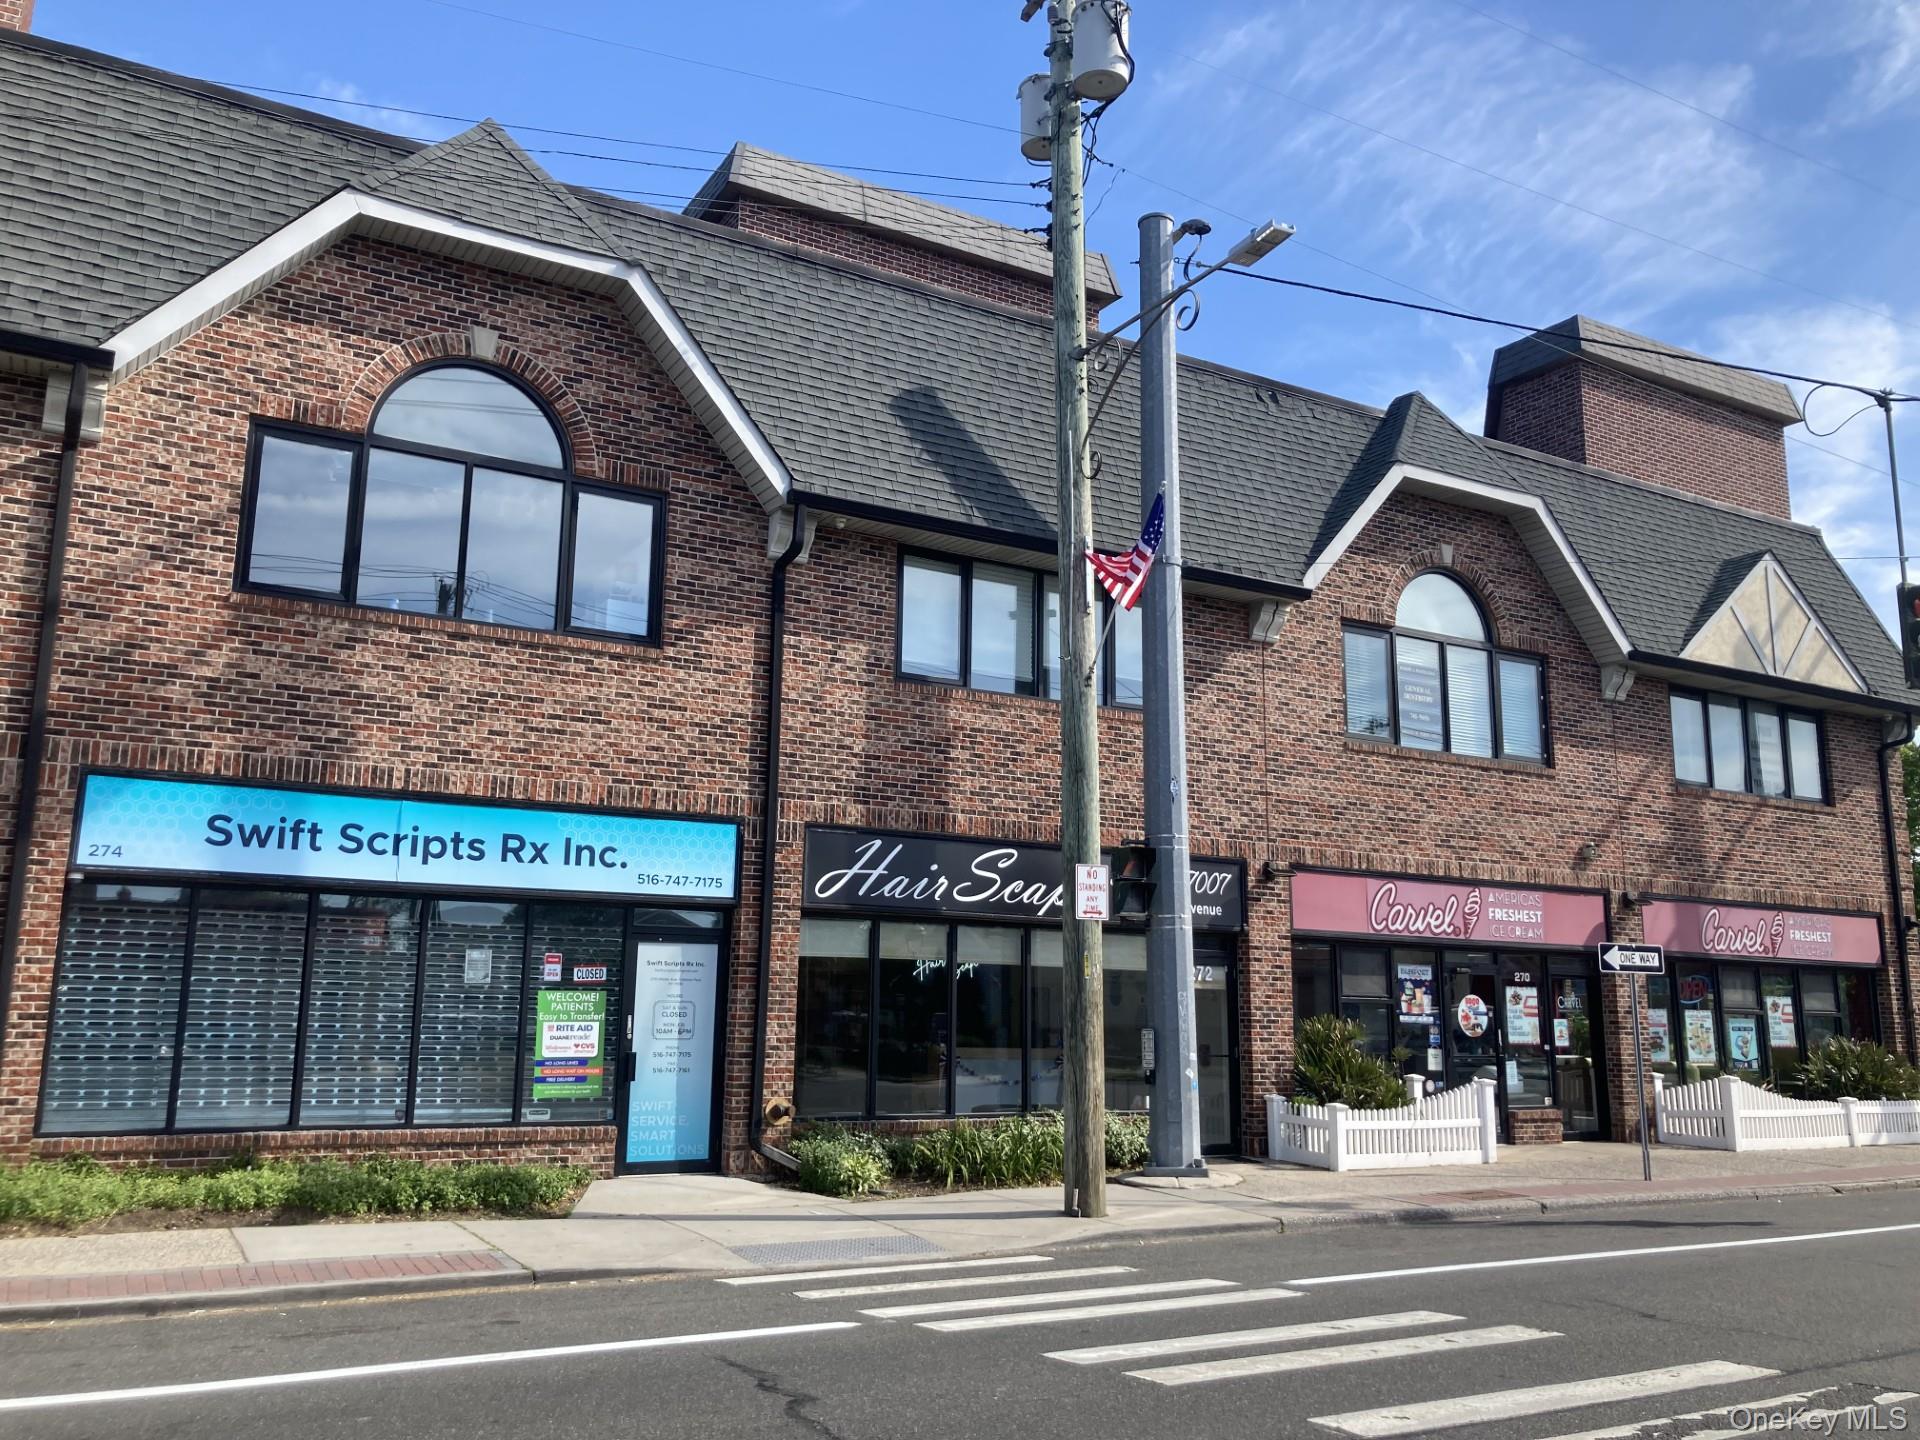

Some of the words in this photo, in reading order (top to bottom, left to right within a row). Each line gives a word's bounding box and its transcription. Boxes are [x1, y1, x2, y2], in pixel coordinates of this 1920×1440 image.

[204, 814, 323, 852] Swift
[338, 823, 486, 866] Scripts
[501, 833, 549, 865] Rx
[563, 837, 628, 869] Inc.
[88, 845, 123, 858] 274
[814, 839, 949, 901] Hair
[953, 849, 1064, 916] Scap
[1086, 870, 1098, 879] NO
[637, 874, 723, 889] 516-747-7175
[1078, 883, 1106, 893] STANDING
[1190, 904, 1223, 916] venue
[1370, 882, 1460, 936] Carvel
[1488, 908, 1543, 923] FRESHEST
[1488, 925, 1506, 938] ICE
[1508, 926, 1544, 940] CREAM
[1701, 907, 1768, 953] Carvel
[1789, 929, 1832, 942] FRESHEST
[1620, 952, 1636, 964] ONE
[1639, 953, 1656, 965] WAY
[576, 968, 604, 980] CLOSED
[1514, 972, 1531, 982] 270
[546, 992, 600, 1001] WELCOME!
[551, 1002, 594, 1011] PATIENTS
[540, 1012, 558, 1021] Easy
[560, 1012, 567, 1020] to
[570, 1012, 605, 1021] Transfer!
[556, 1024, 575, 1032] RITE
[577, 1024, 593, 1032] AID
[632, 1100, 673, 1112] SWIFT
[631, 1130, 676, 1142] SMART
[630, 1144, 705, 1157] SOLUTIONS
